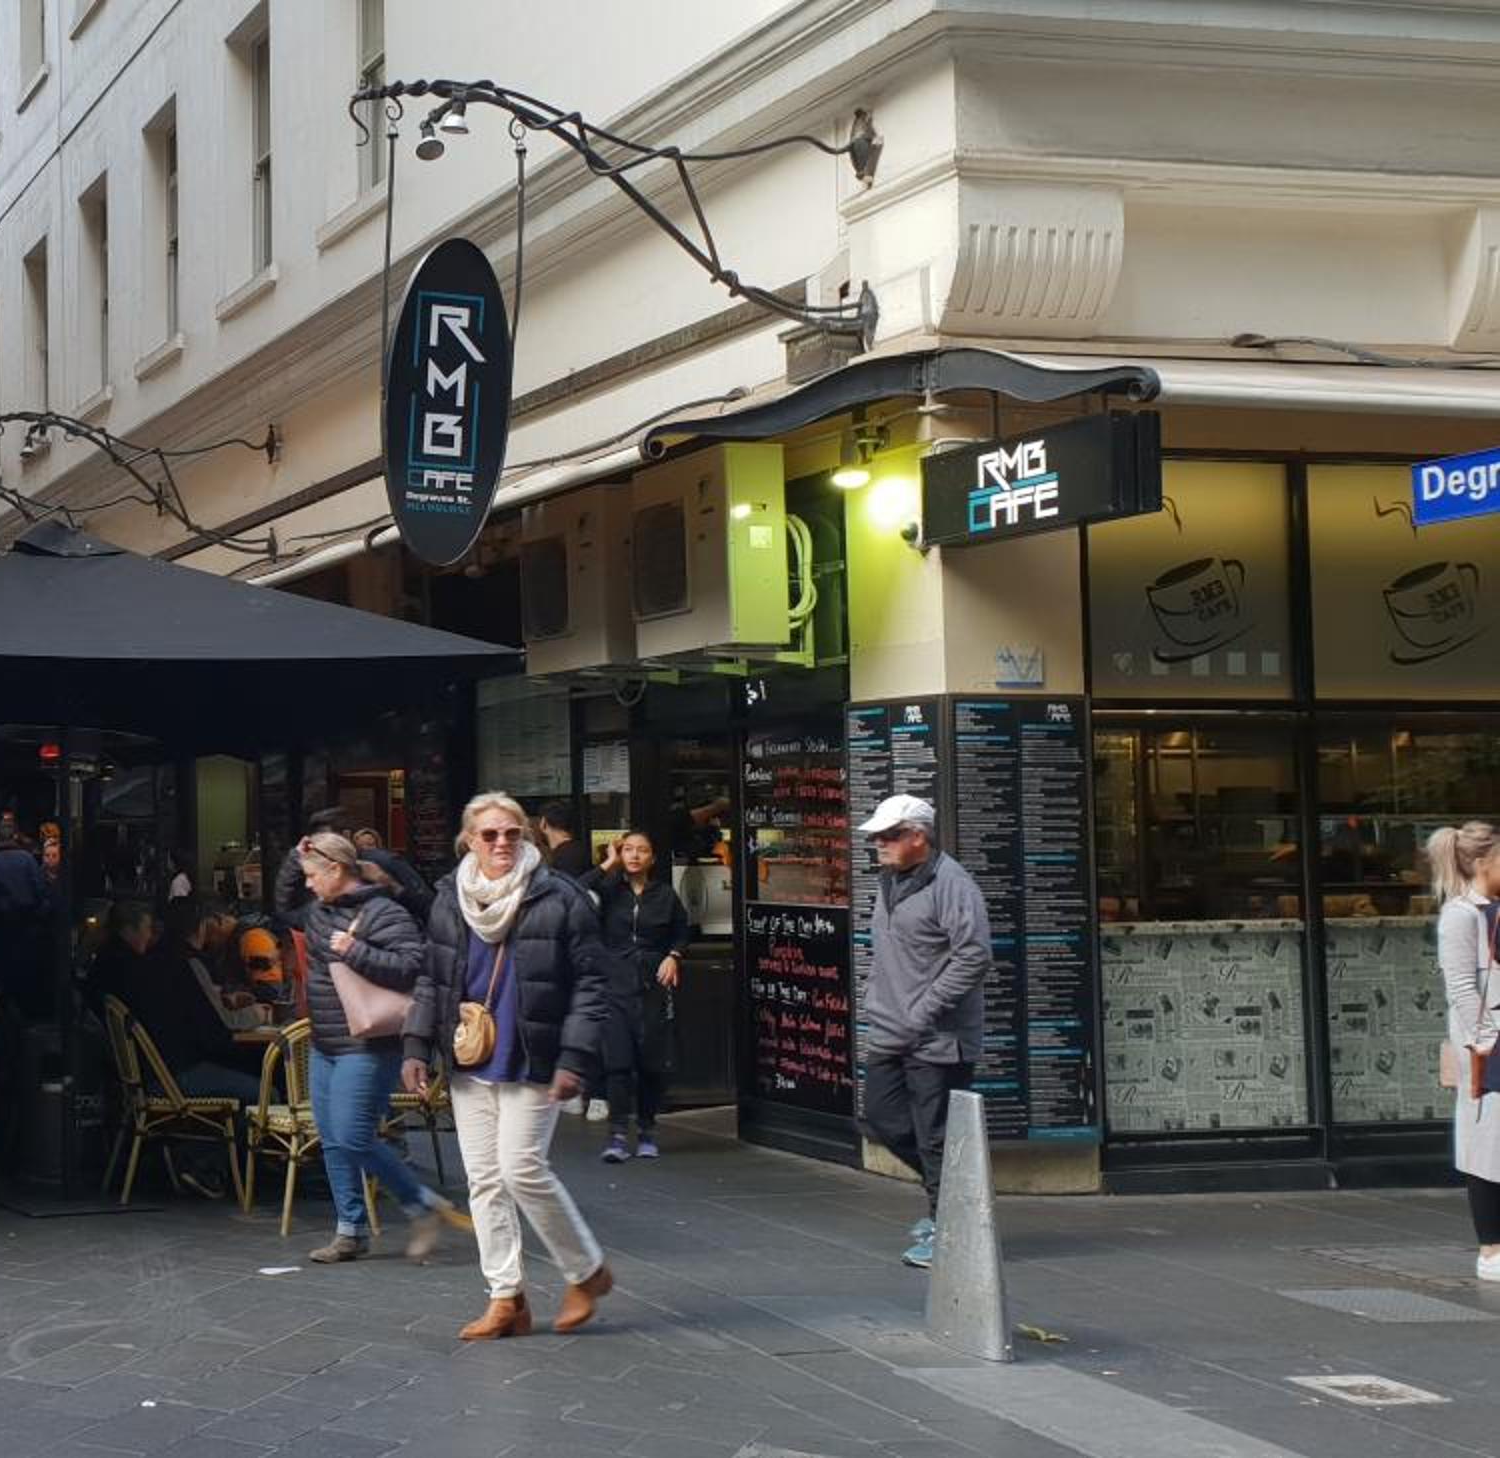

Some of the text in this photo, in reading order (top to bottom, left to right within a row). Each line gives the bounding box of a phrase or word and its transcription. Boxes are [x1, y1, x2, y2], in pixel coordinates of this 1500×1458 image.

[423, 303, 487, 457] RMB
[407, 468, 474, 491] CAFE
[978, 440, 1047, 490] RMB
[1422, 462, 1500, 501] Degr
[968, 480, 1059, 532] CAFE
